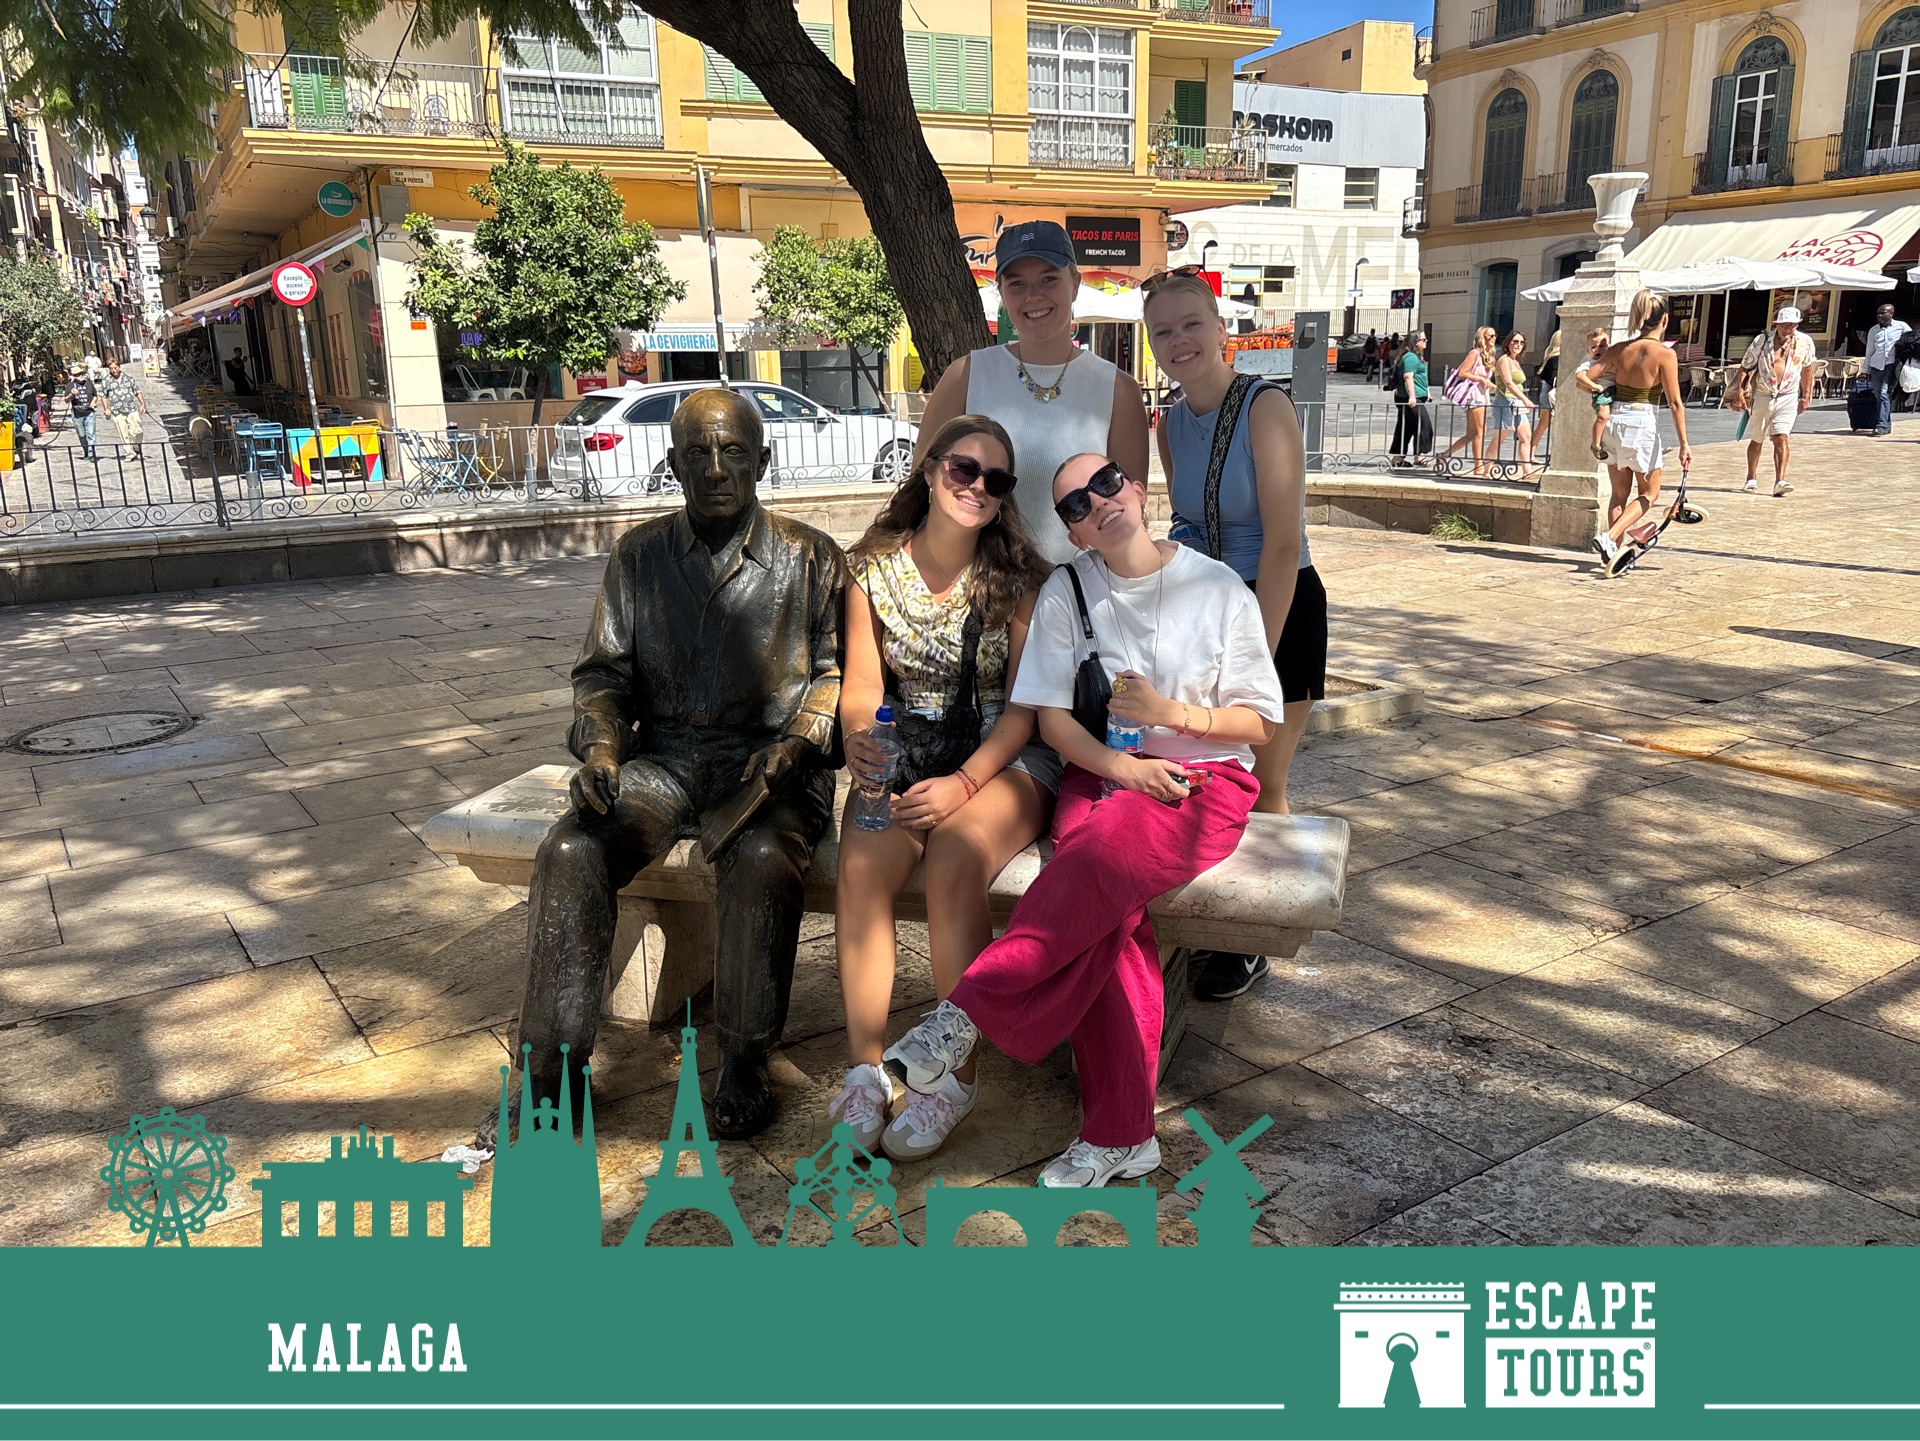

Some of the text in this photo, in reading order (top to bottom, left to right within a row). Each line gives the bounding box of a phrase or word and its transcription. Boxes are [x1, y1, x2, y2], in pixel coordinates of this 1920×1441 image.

[1071, 230, 1139, 242] TACOS DE PARIS
[1788, 238, 1819, 249] LA
[1233, 243, 1261, 263] DE
[1268, 244, 1295, 265] LA
[642, 333, 717, 350] LA CEVICHERÍA
